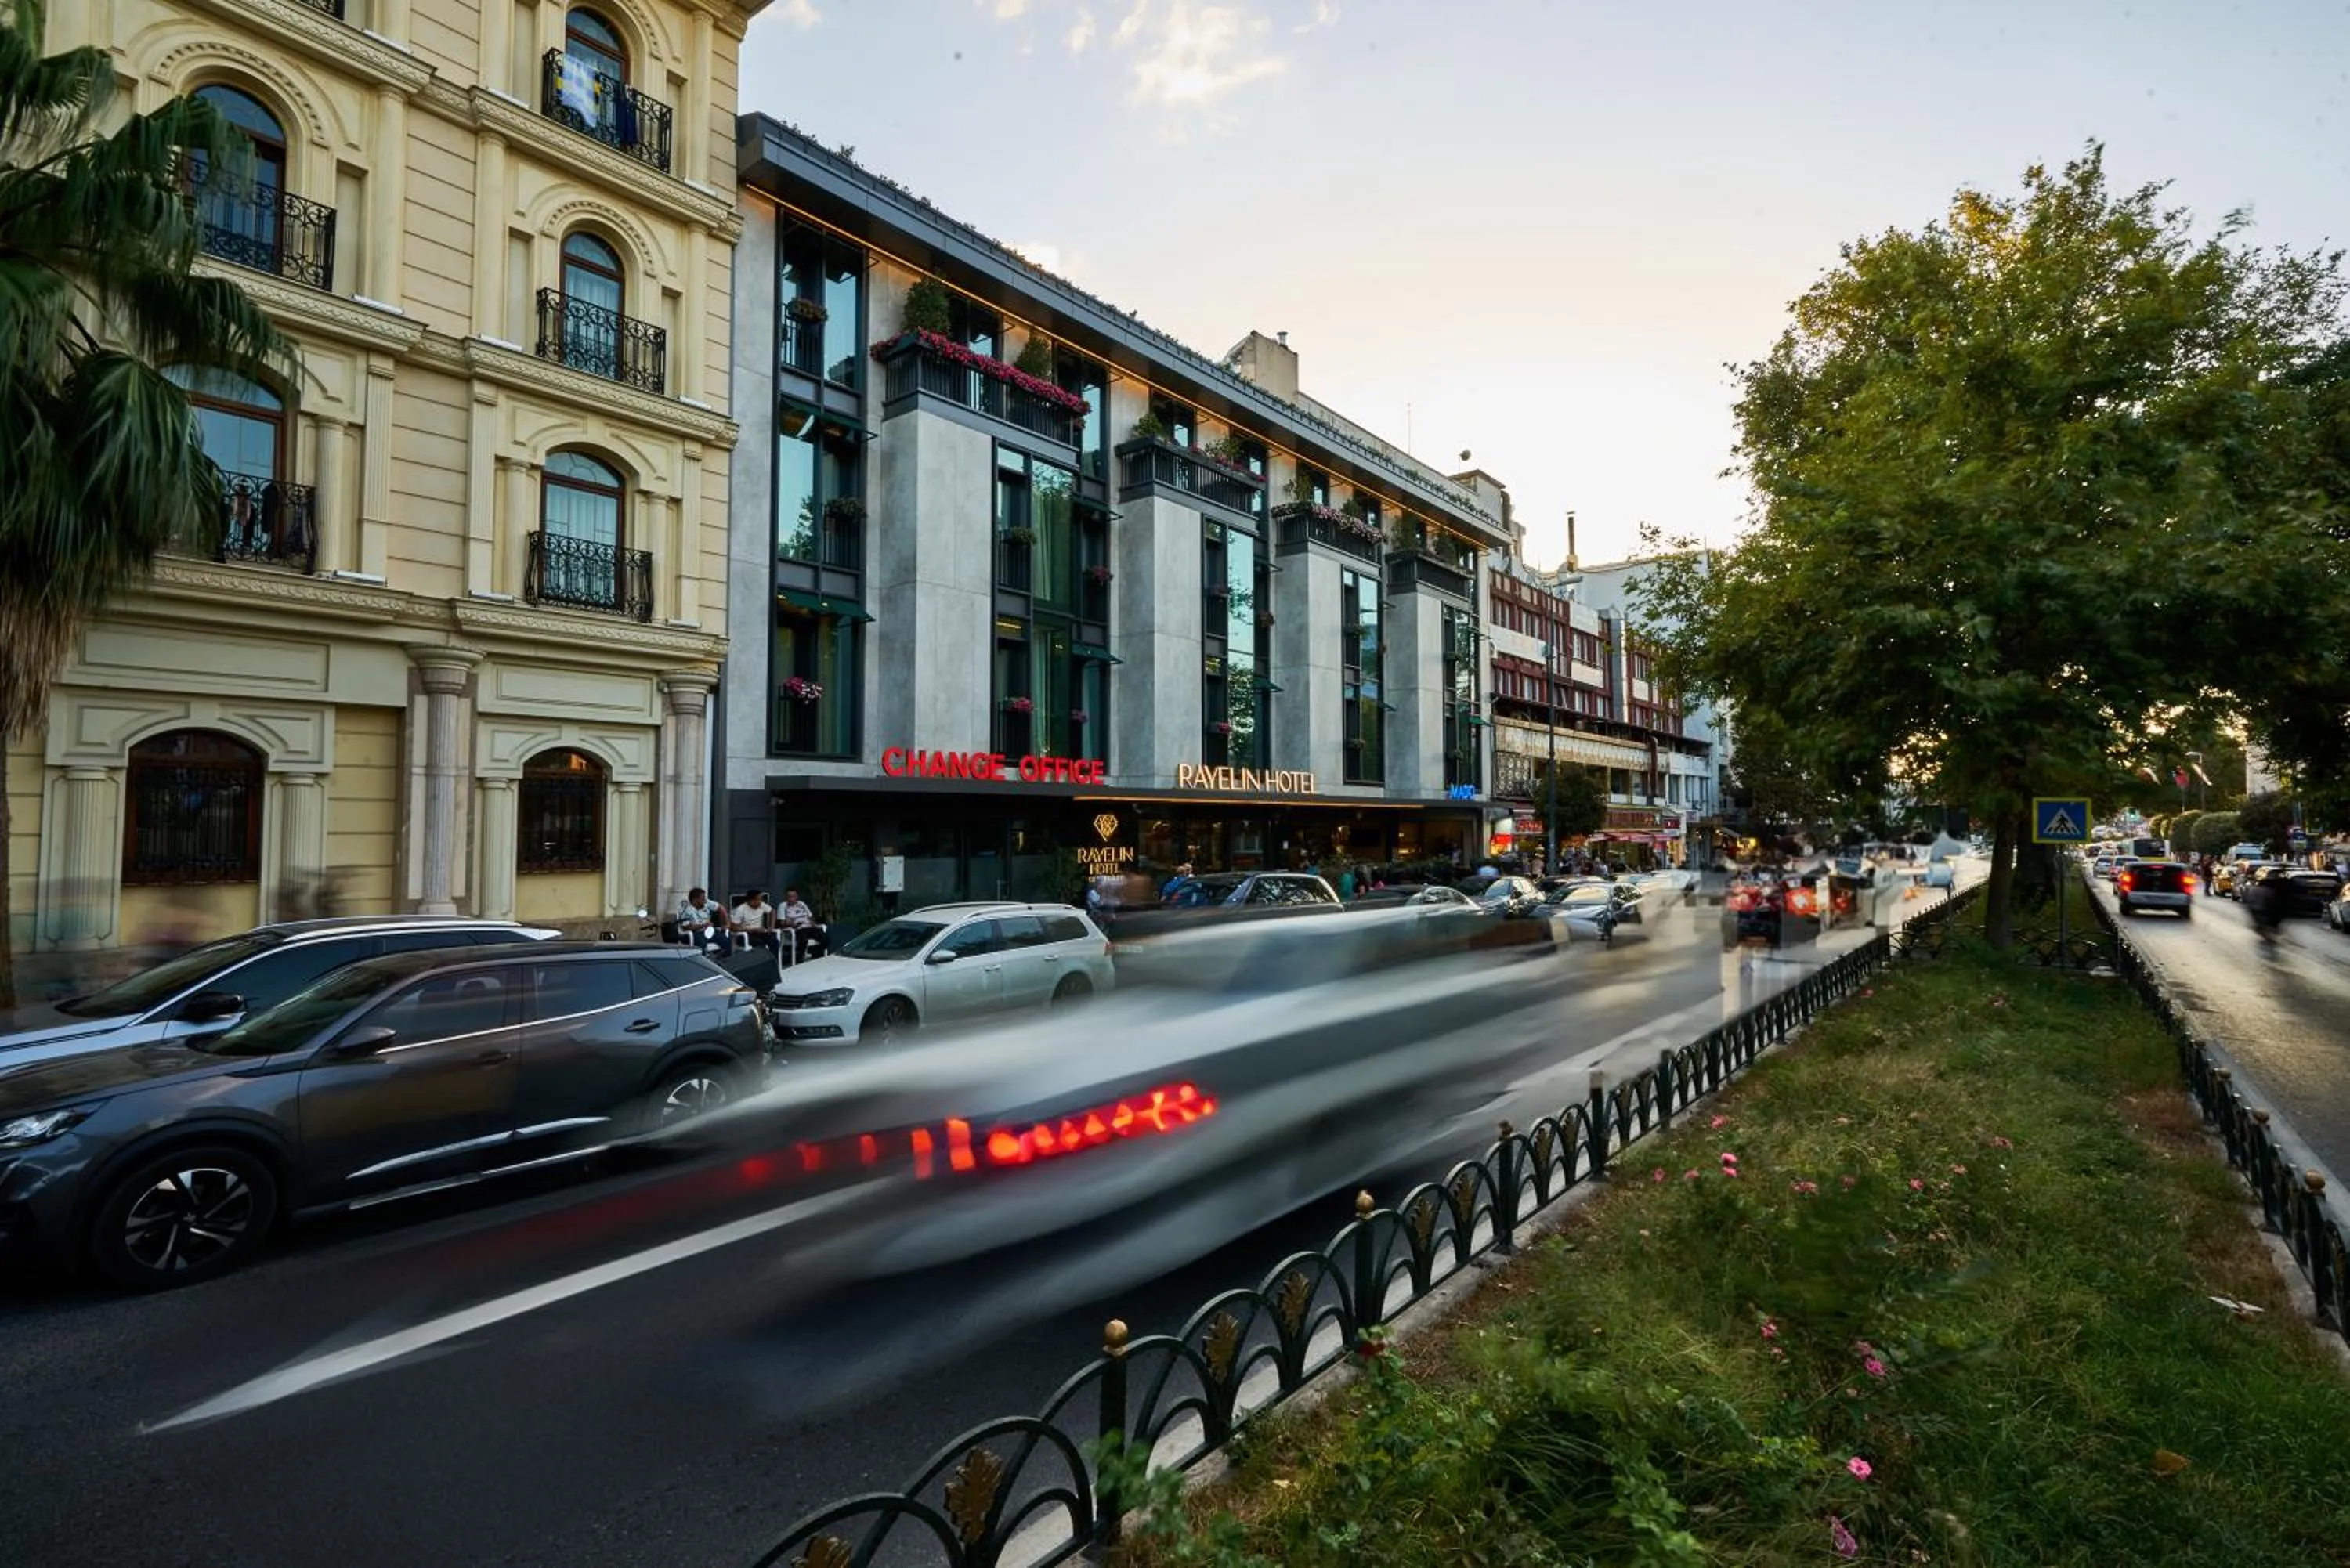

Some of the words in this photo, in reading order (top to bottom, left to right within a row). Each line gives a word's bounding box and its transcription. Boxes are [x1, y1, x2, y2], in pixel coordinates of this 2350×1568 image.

[882, 746, 1006, 781] CHANGE
[1019, 755, 1104, 785] OFFICE
[1178, 764, 1260, 791] RAYELIN
[1265, 768, 1317, 793] HOTEL
[1077, 847, 1133, 863] RAYELIN
